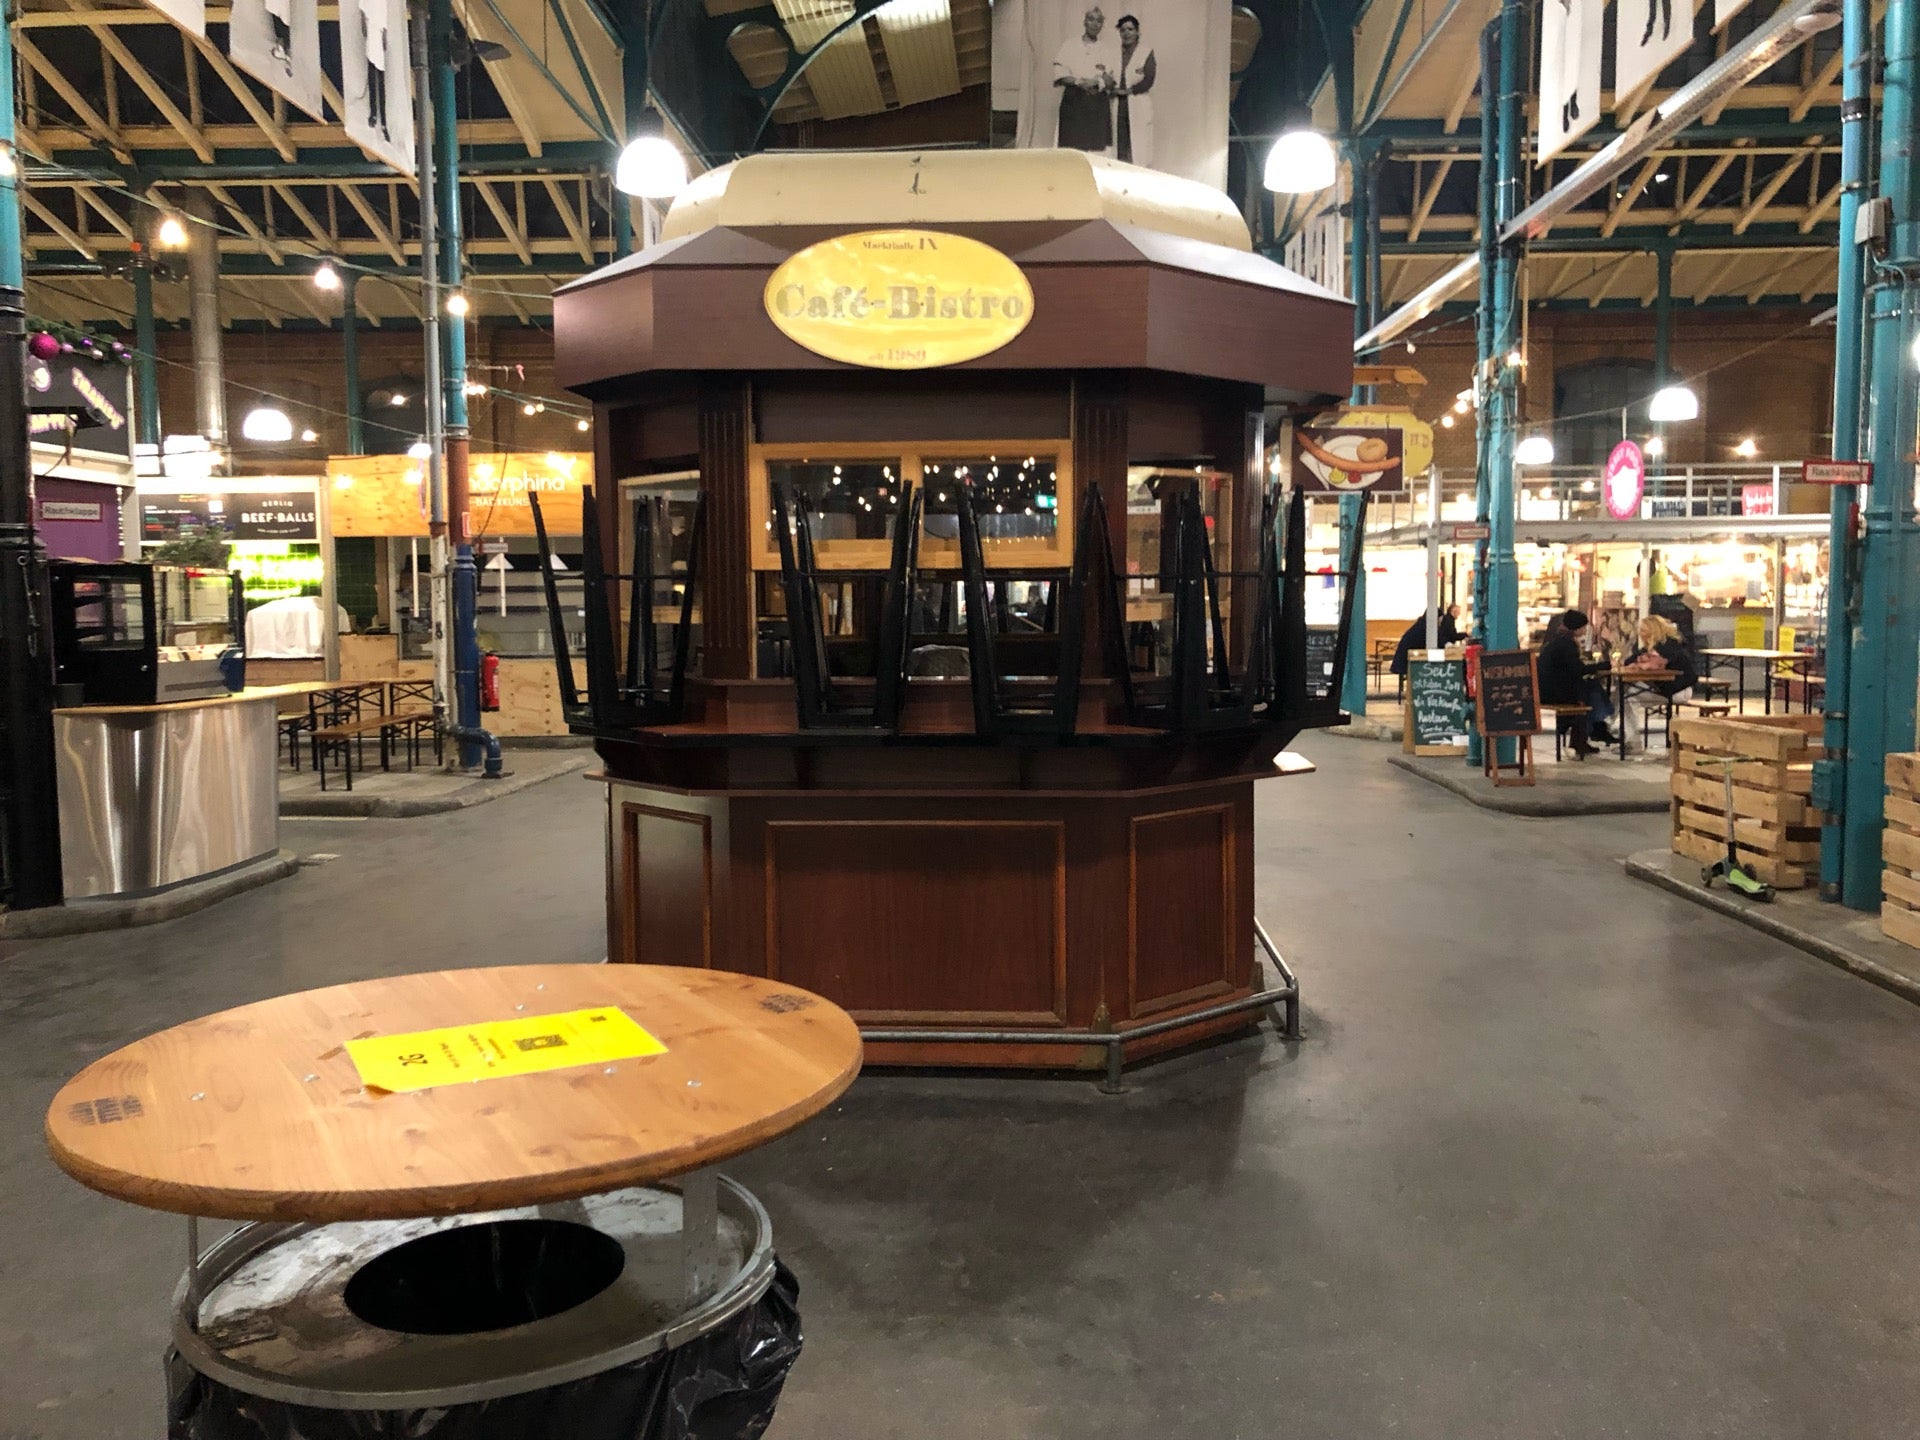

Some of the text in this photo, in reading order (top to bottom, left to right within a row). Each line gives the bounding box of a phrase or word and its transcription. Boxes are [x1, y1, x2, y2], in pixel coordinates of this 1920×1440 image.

[862, 238, 937, 250] Markthalle IX
[776, 284, 1024, 319] Café-Bistro
[469, 469, 565, 496] ndorphina
[261, 500, 294, 508] BERLIN
[1419, 662, 1457, 678] Seit
[398, 1053, 429, 1067] 2G
